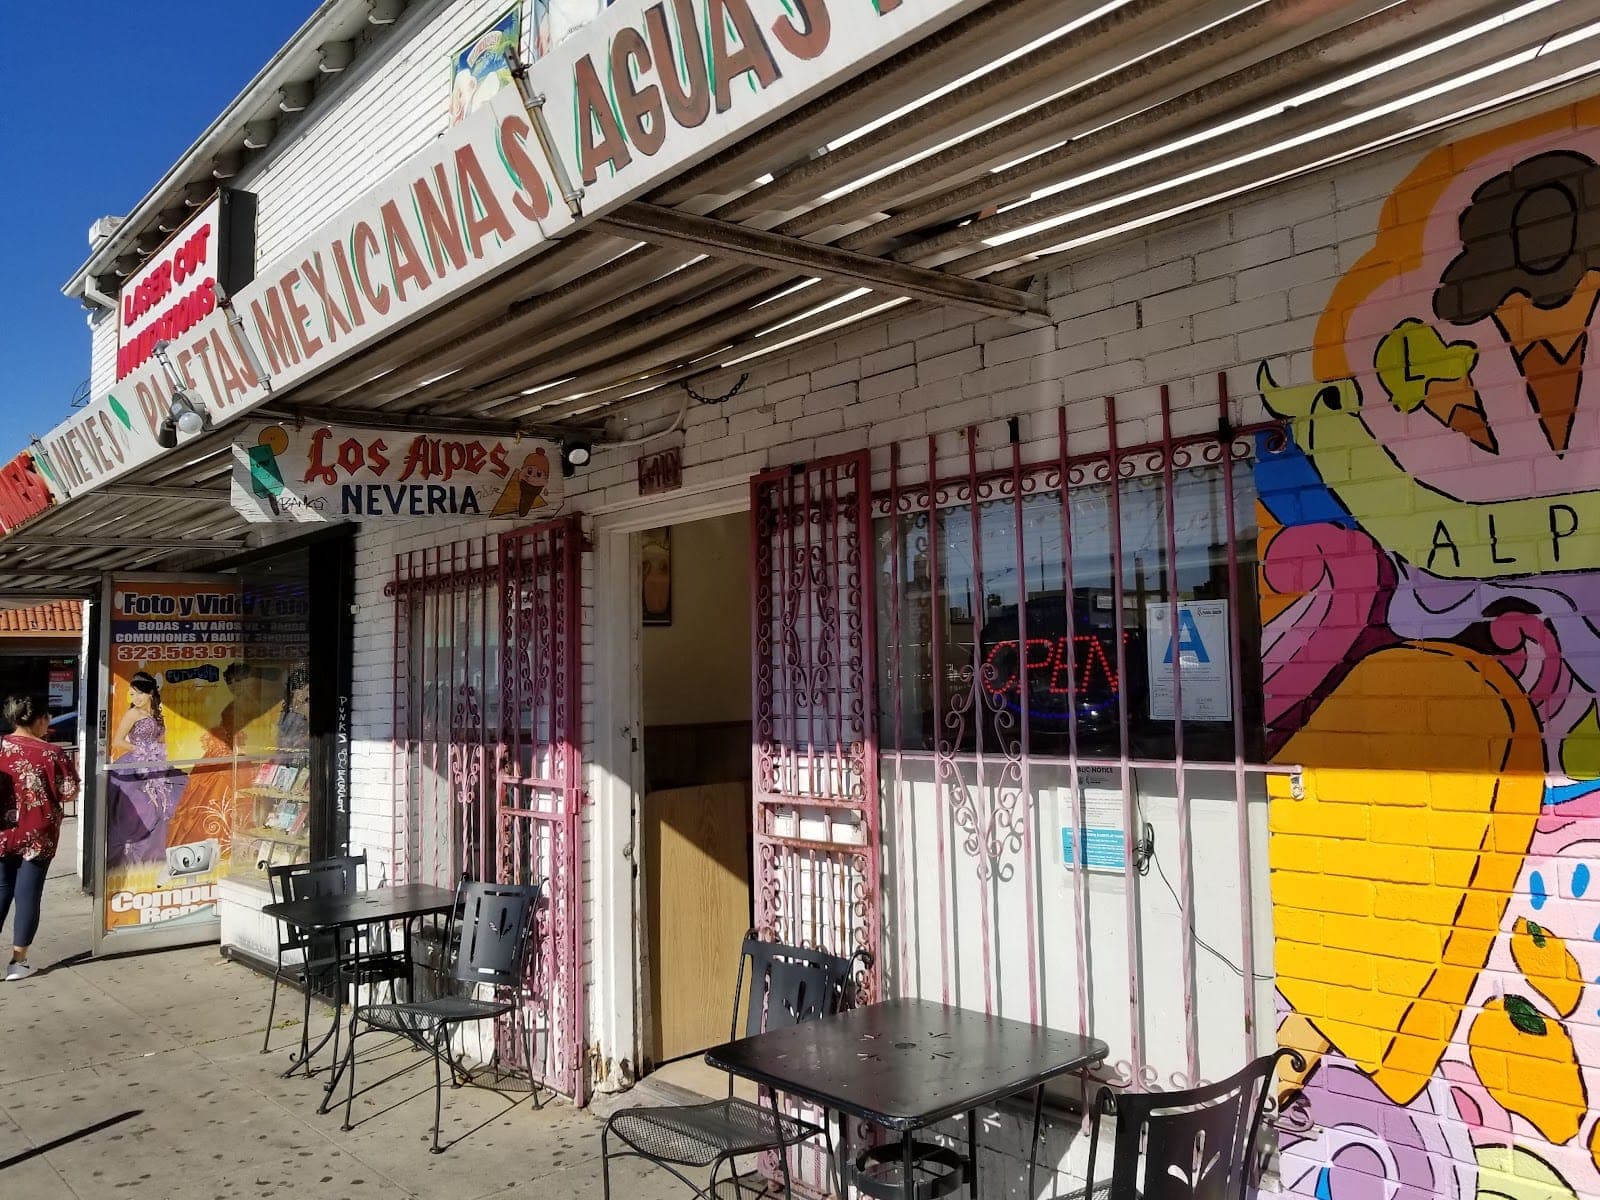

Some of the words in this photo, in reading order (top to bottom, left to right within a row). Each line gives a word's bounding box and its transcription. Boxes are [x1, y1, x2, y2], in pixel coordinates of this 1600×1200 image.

[51, 409, 125, 490] NIEVES
[250, 114, 552, 376] MEXICANAS
[303, 427, 391, 486] Los
[398, 434, 511, 482] Alpes
[341, 484, 482, 516] NEVERIA
[1426, 502, 1579, 570] ALP
[123, 592, 175, 615] Foto
[178, 596, 195, 617] y
[137, 621, 180, 632] BODAS
[192, 621, 209, 632] XV
[115, 633, 197, 643] COMUNIONES
[201, 633, 209, 642] Y
[983, 631, 1129, 695] OPEN
[1162, 609, 1211, 664] A
